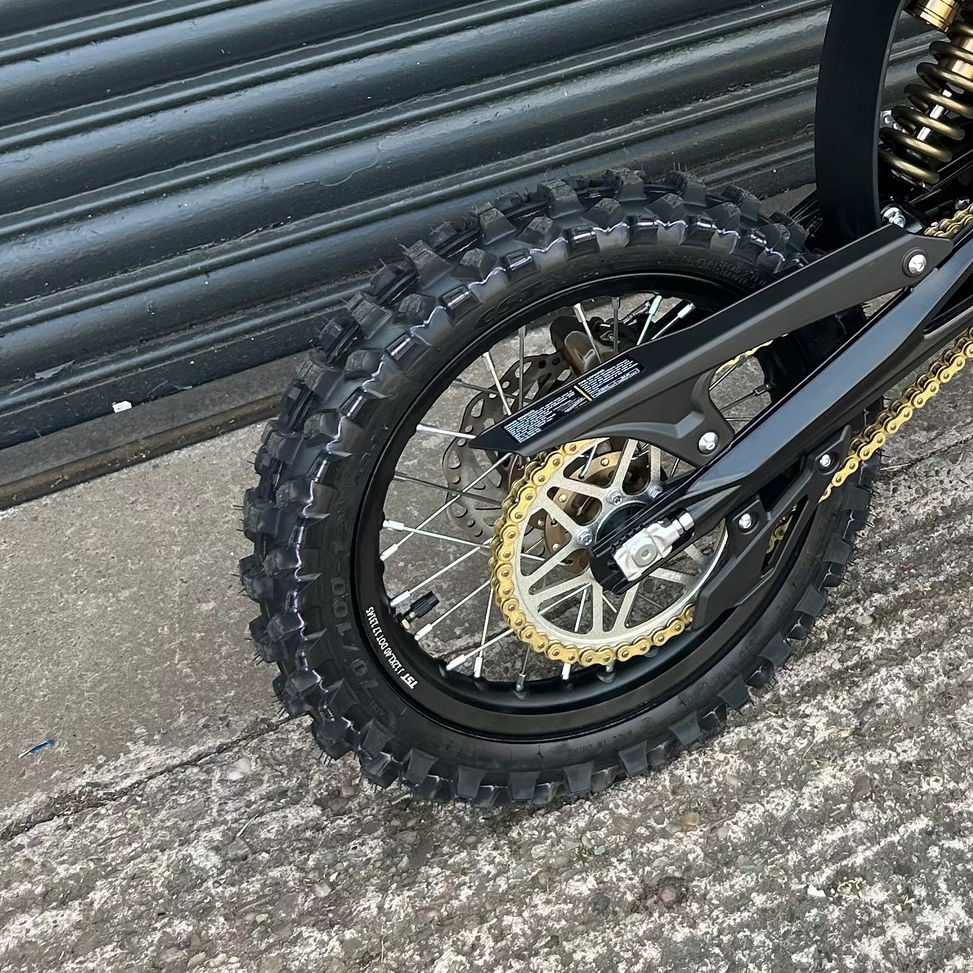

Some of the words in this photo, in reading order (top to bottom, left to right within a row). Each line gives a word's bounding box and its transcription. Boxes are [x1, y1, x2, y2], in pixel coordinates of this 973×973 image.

[365, 606, 379, 629] 13145
[375, 634, 388, 650] DOT
[400, 672, 419, 690] TST
